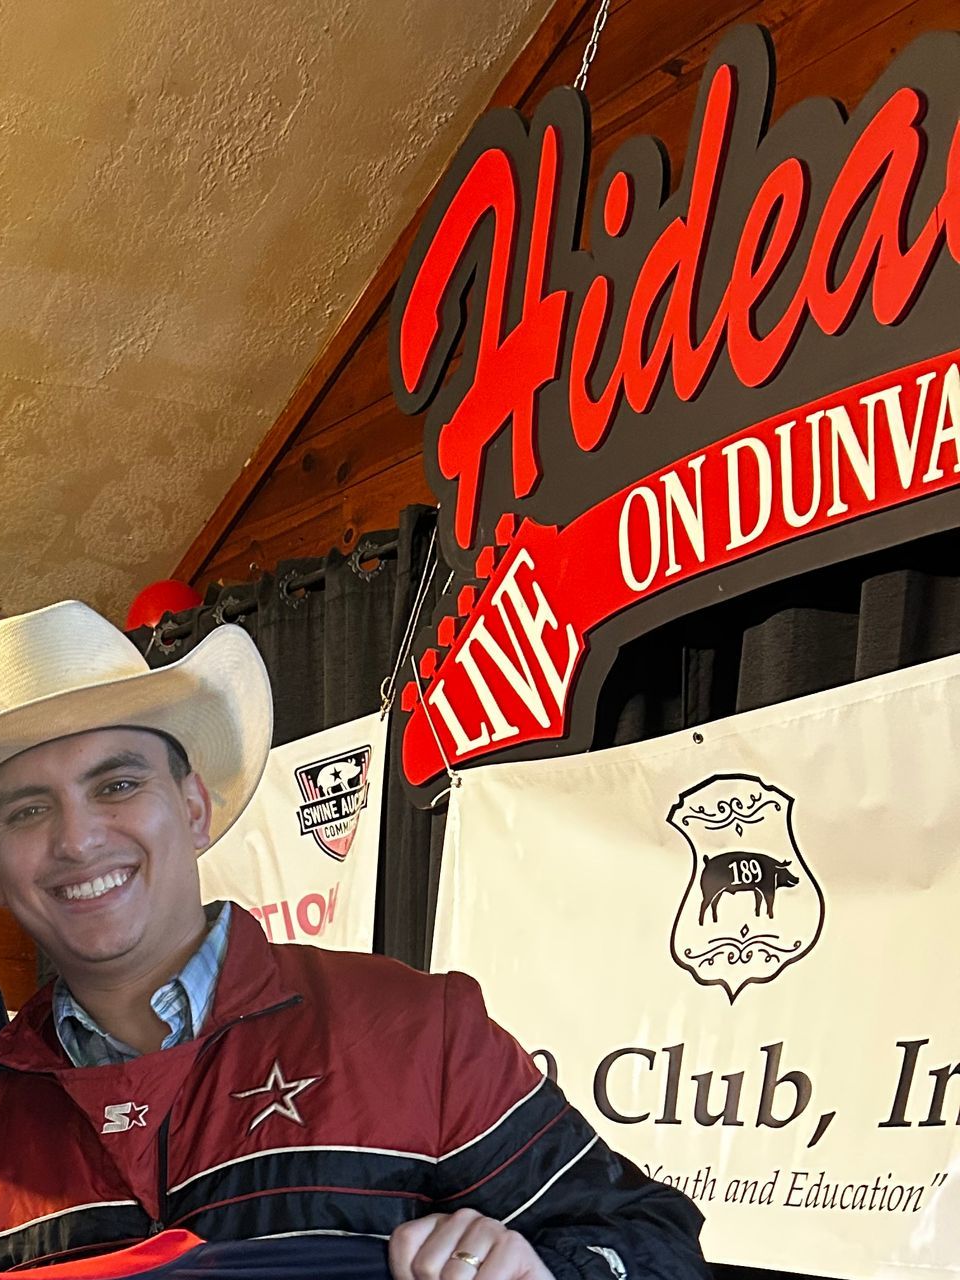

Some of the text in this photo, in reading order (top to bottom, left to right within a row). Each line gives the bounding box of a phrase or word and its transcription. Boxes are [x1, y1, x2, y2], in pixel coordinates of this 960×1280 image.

[400, 63, 960, 552] Hidea
[428, 363, 960, 757] LIVE ON DUNVA
[302, 800, 340, 826] SWINE
[728, 859, 762, 885] 189
[248, 881, 340, 943] TION
[592, 1042, 836, 1148] Club,
[724, 1169, 781, 1206] and
